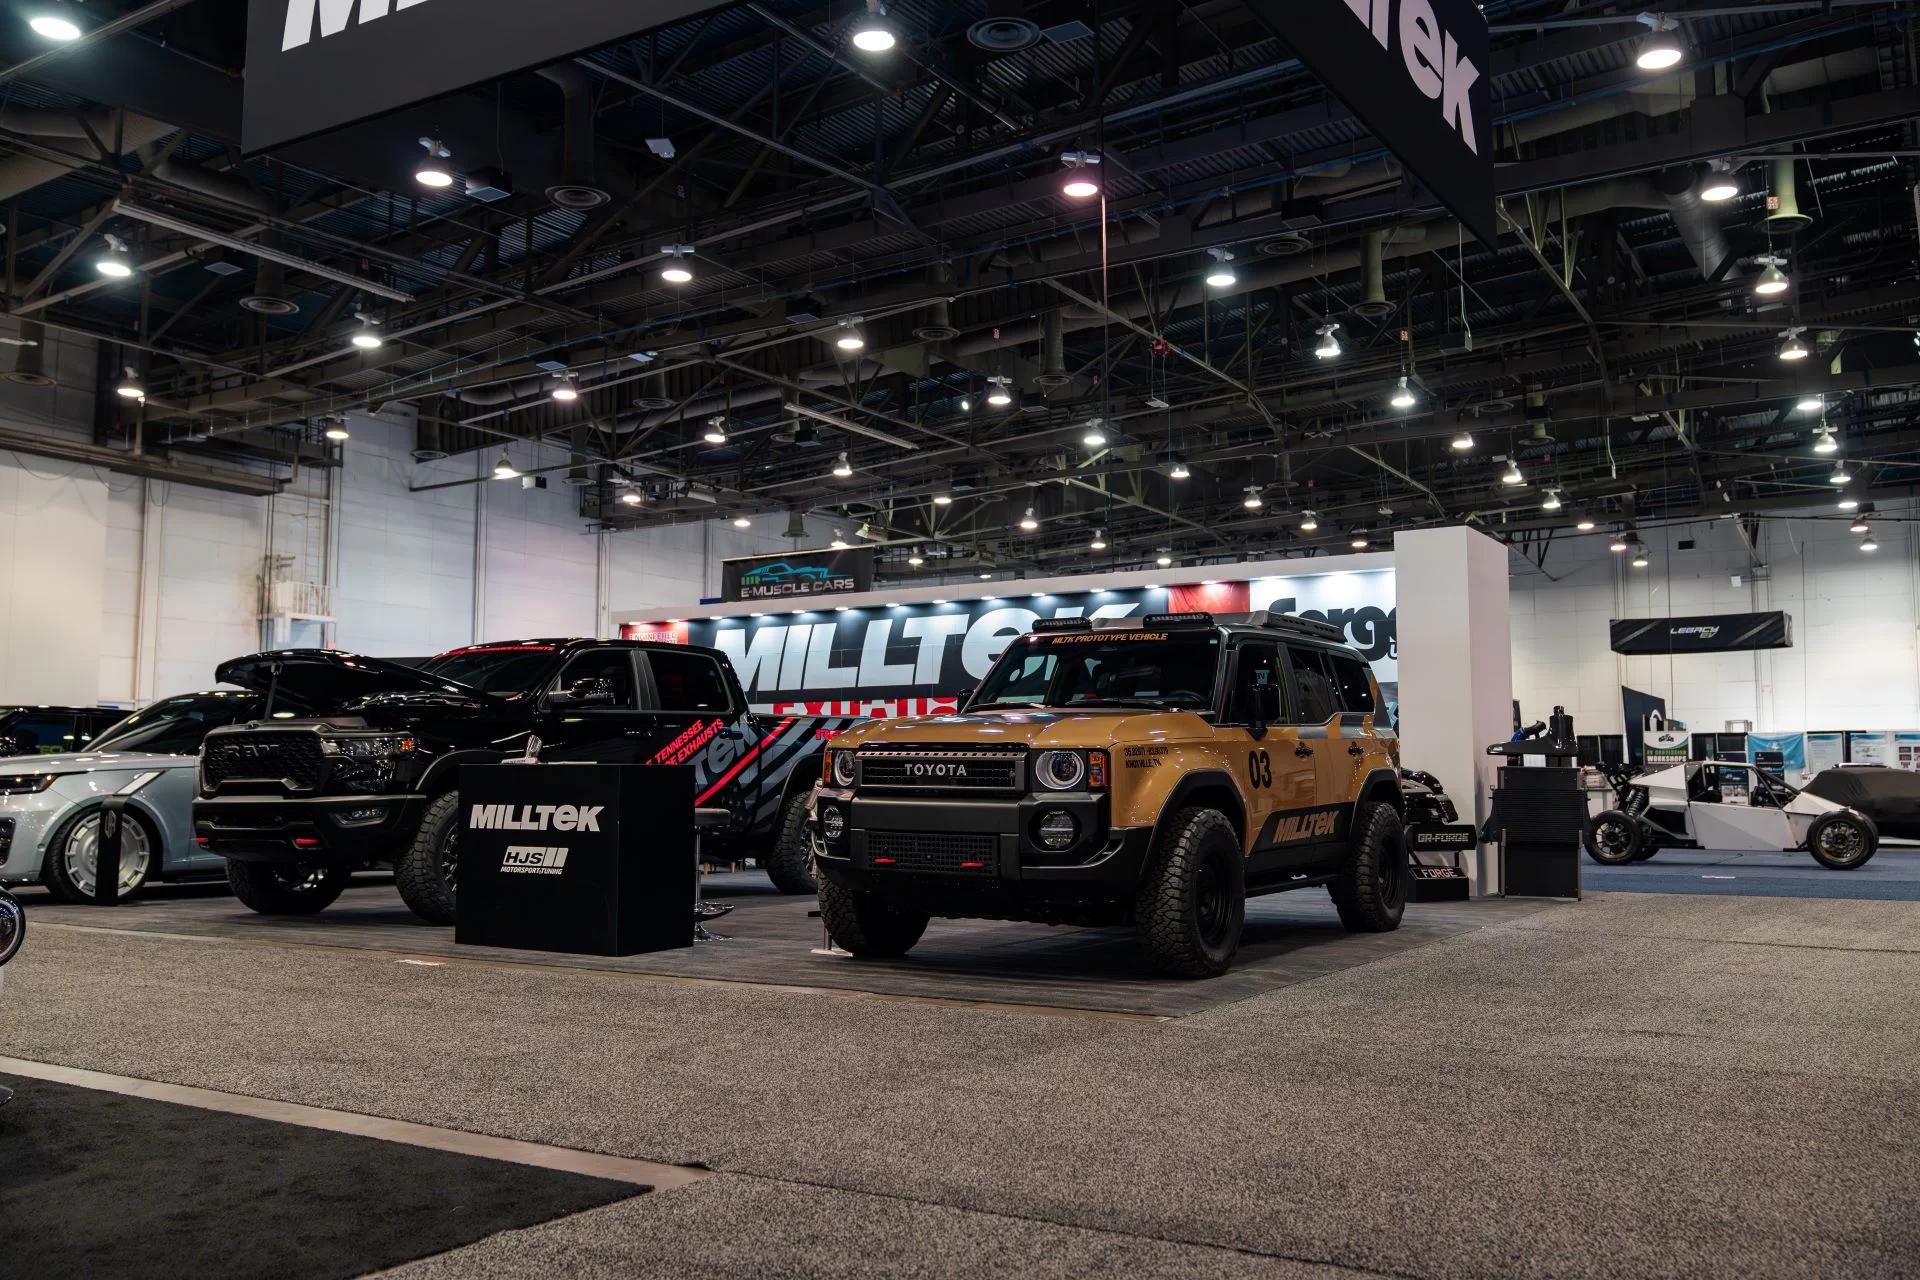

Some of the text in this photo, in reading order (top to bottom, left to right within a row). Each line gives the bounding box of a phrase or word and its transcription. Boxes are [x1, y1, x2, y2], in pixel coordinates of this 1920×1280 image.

[741, 583, 810, 598] E-MUSCLE
[813, 578, 855, 592] CARS
[1670, 625, 1720, 634] LEGACY
[1052, 632, 1169, 645] MLTK PROTOTYPE VEHICLE
[655, 720, 704, 763] TENNESSEE
[676, 718, 725, 764] EXHAUSTS
[904, 763, 967, 777] TOYOTA
[1248, 750, 1273, 790] 03
[1417, 832, 1469, 843] GR-FORGE
[505, 851, 544, 864] HJS
[1420, 868, 1458, 878] FORGE
